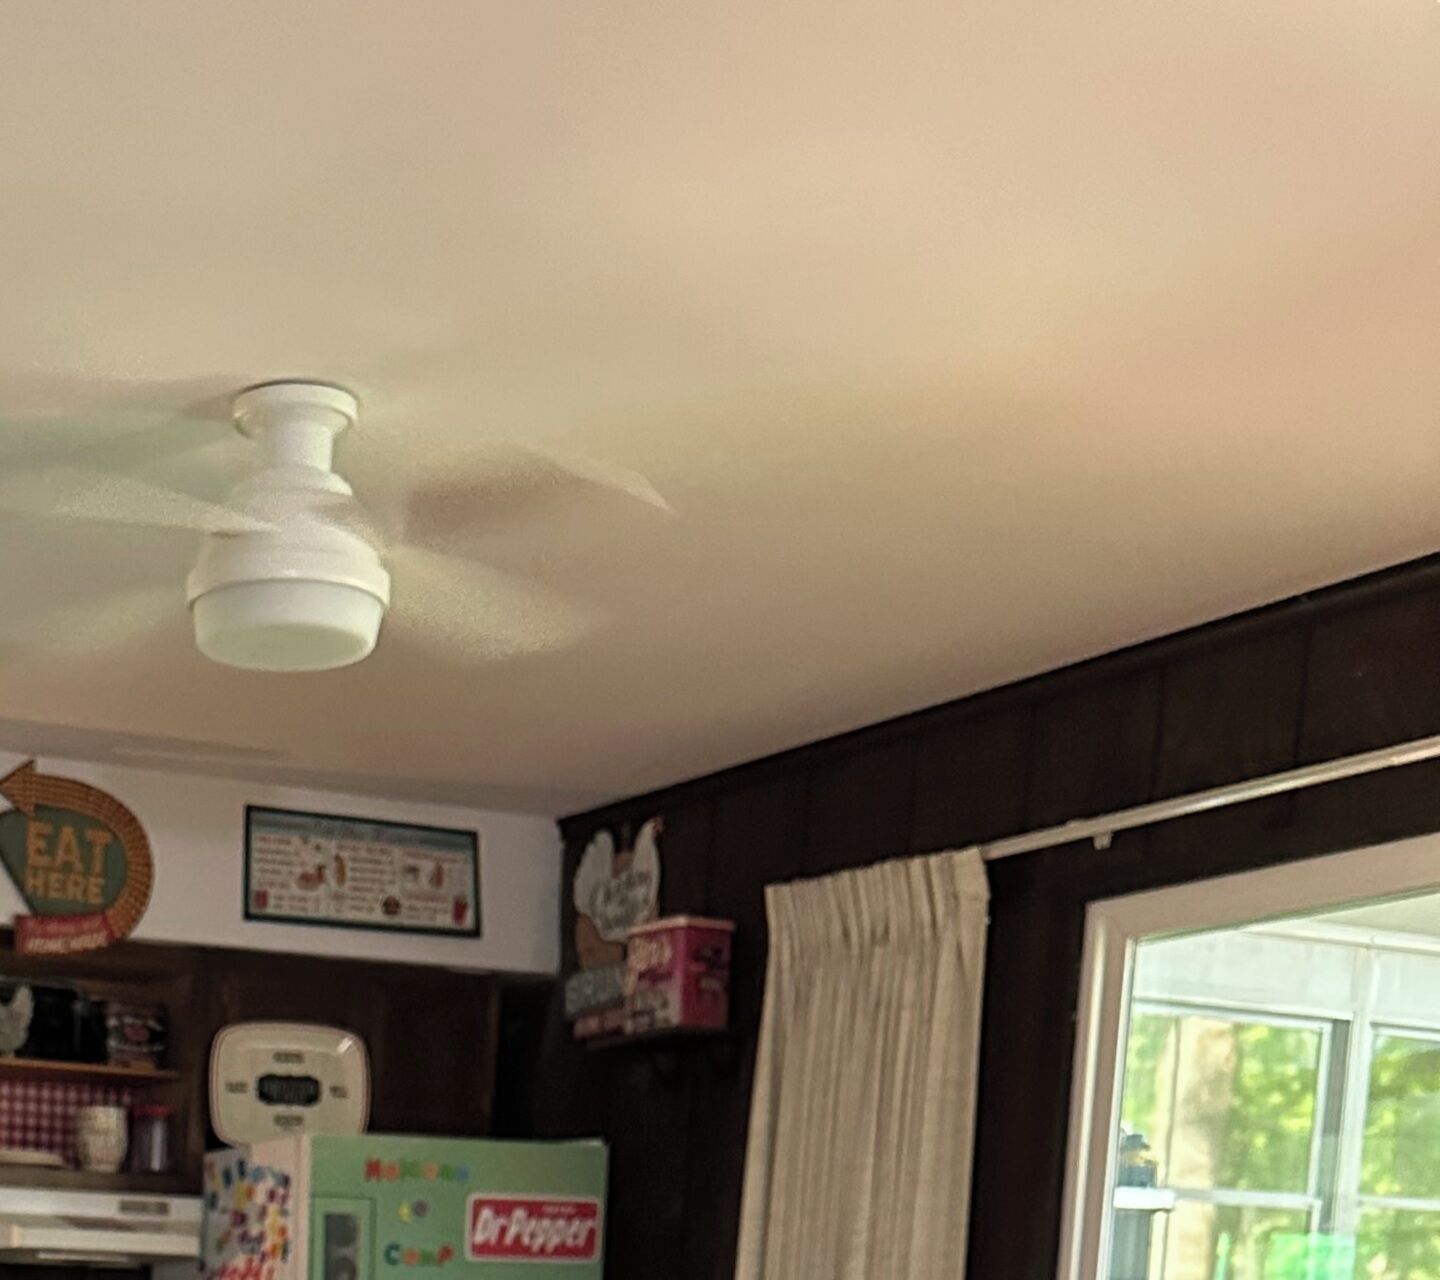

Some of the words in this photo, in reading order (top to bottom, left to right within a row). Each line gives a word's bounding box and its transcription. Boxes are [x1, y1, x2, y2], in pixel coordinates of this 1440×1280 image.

[25, 819, 113, 874] EAT
[25, 867, 105, 904] HERE
[504, 1206, 595, 1254] Pepper
